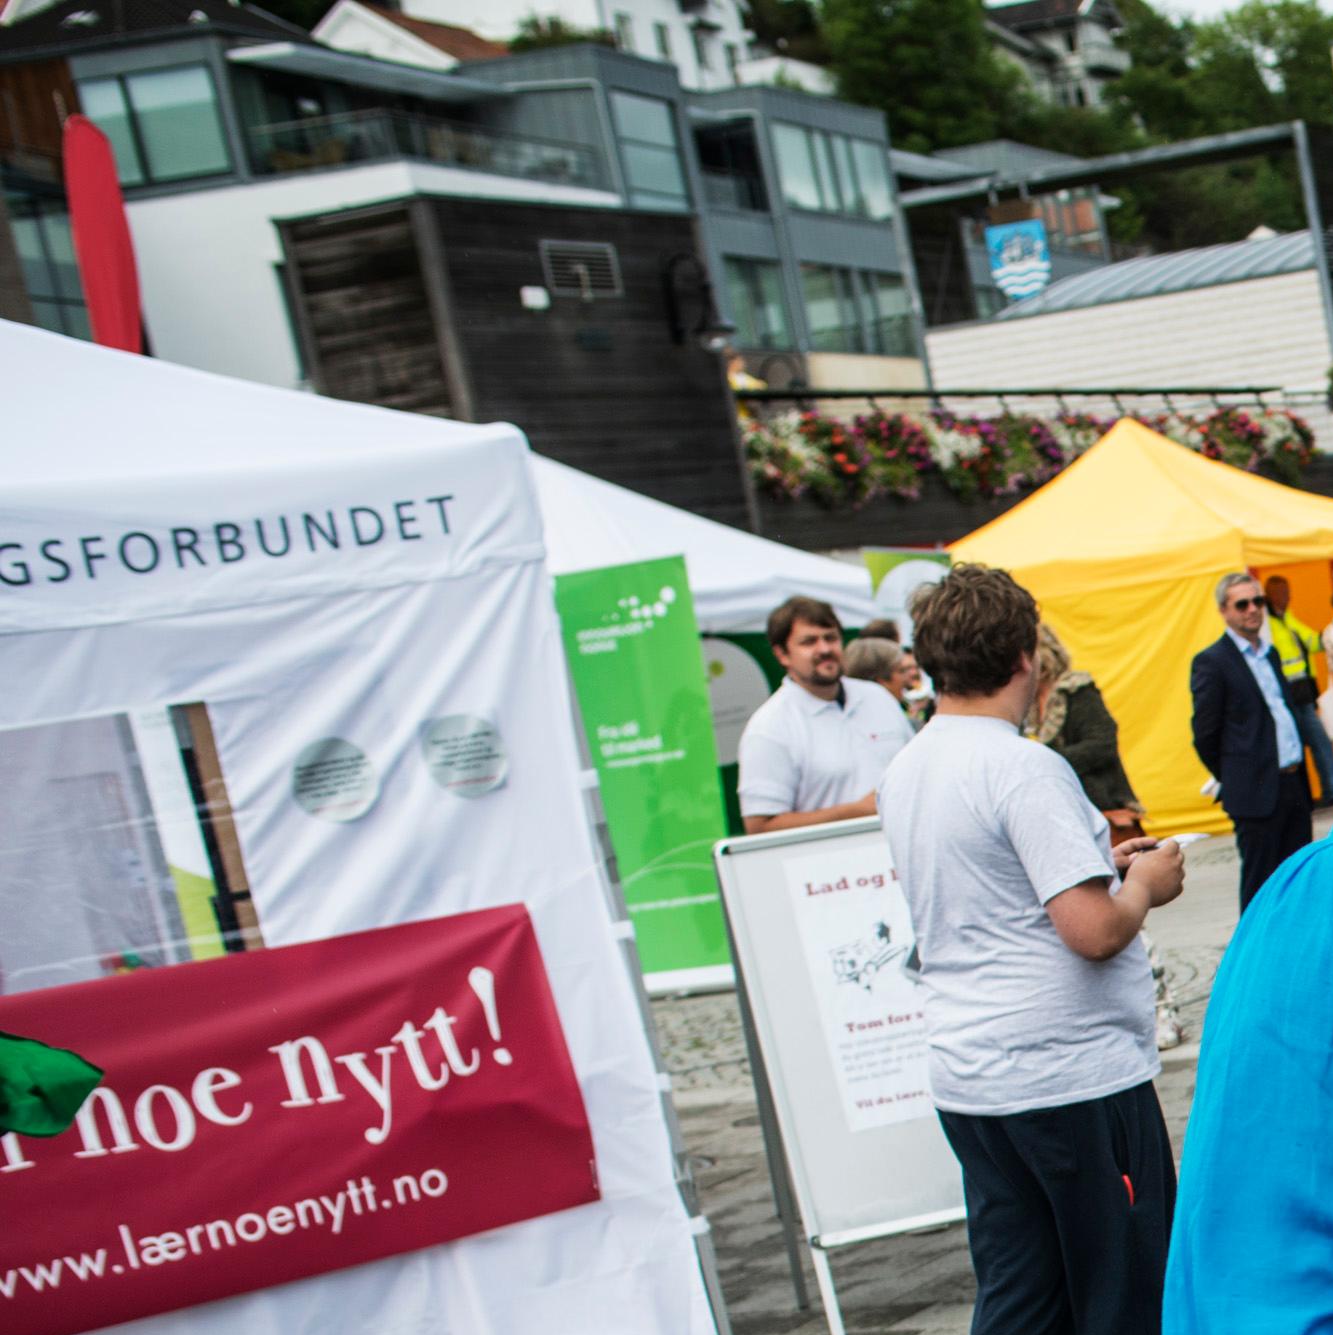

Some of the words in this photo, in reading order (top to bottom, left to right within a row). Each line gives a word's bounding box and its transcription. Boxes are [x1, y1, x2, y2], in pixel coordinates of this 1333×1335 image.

[805, 876, 849, 896] Lad
[856, 873, 885, 889] og
[73, 1067, 254, 1158] noe
[267, 966, 513, 1145] nytt!
